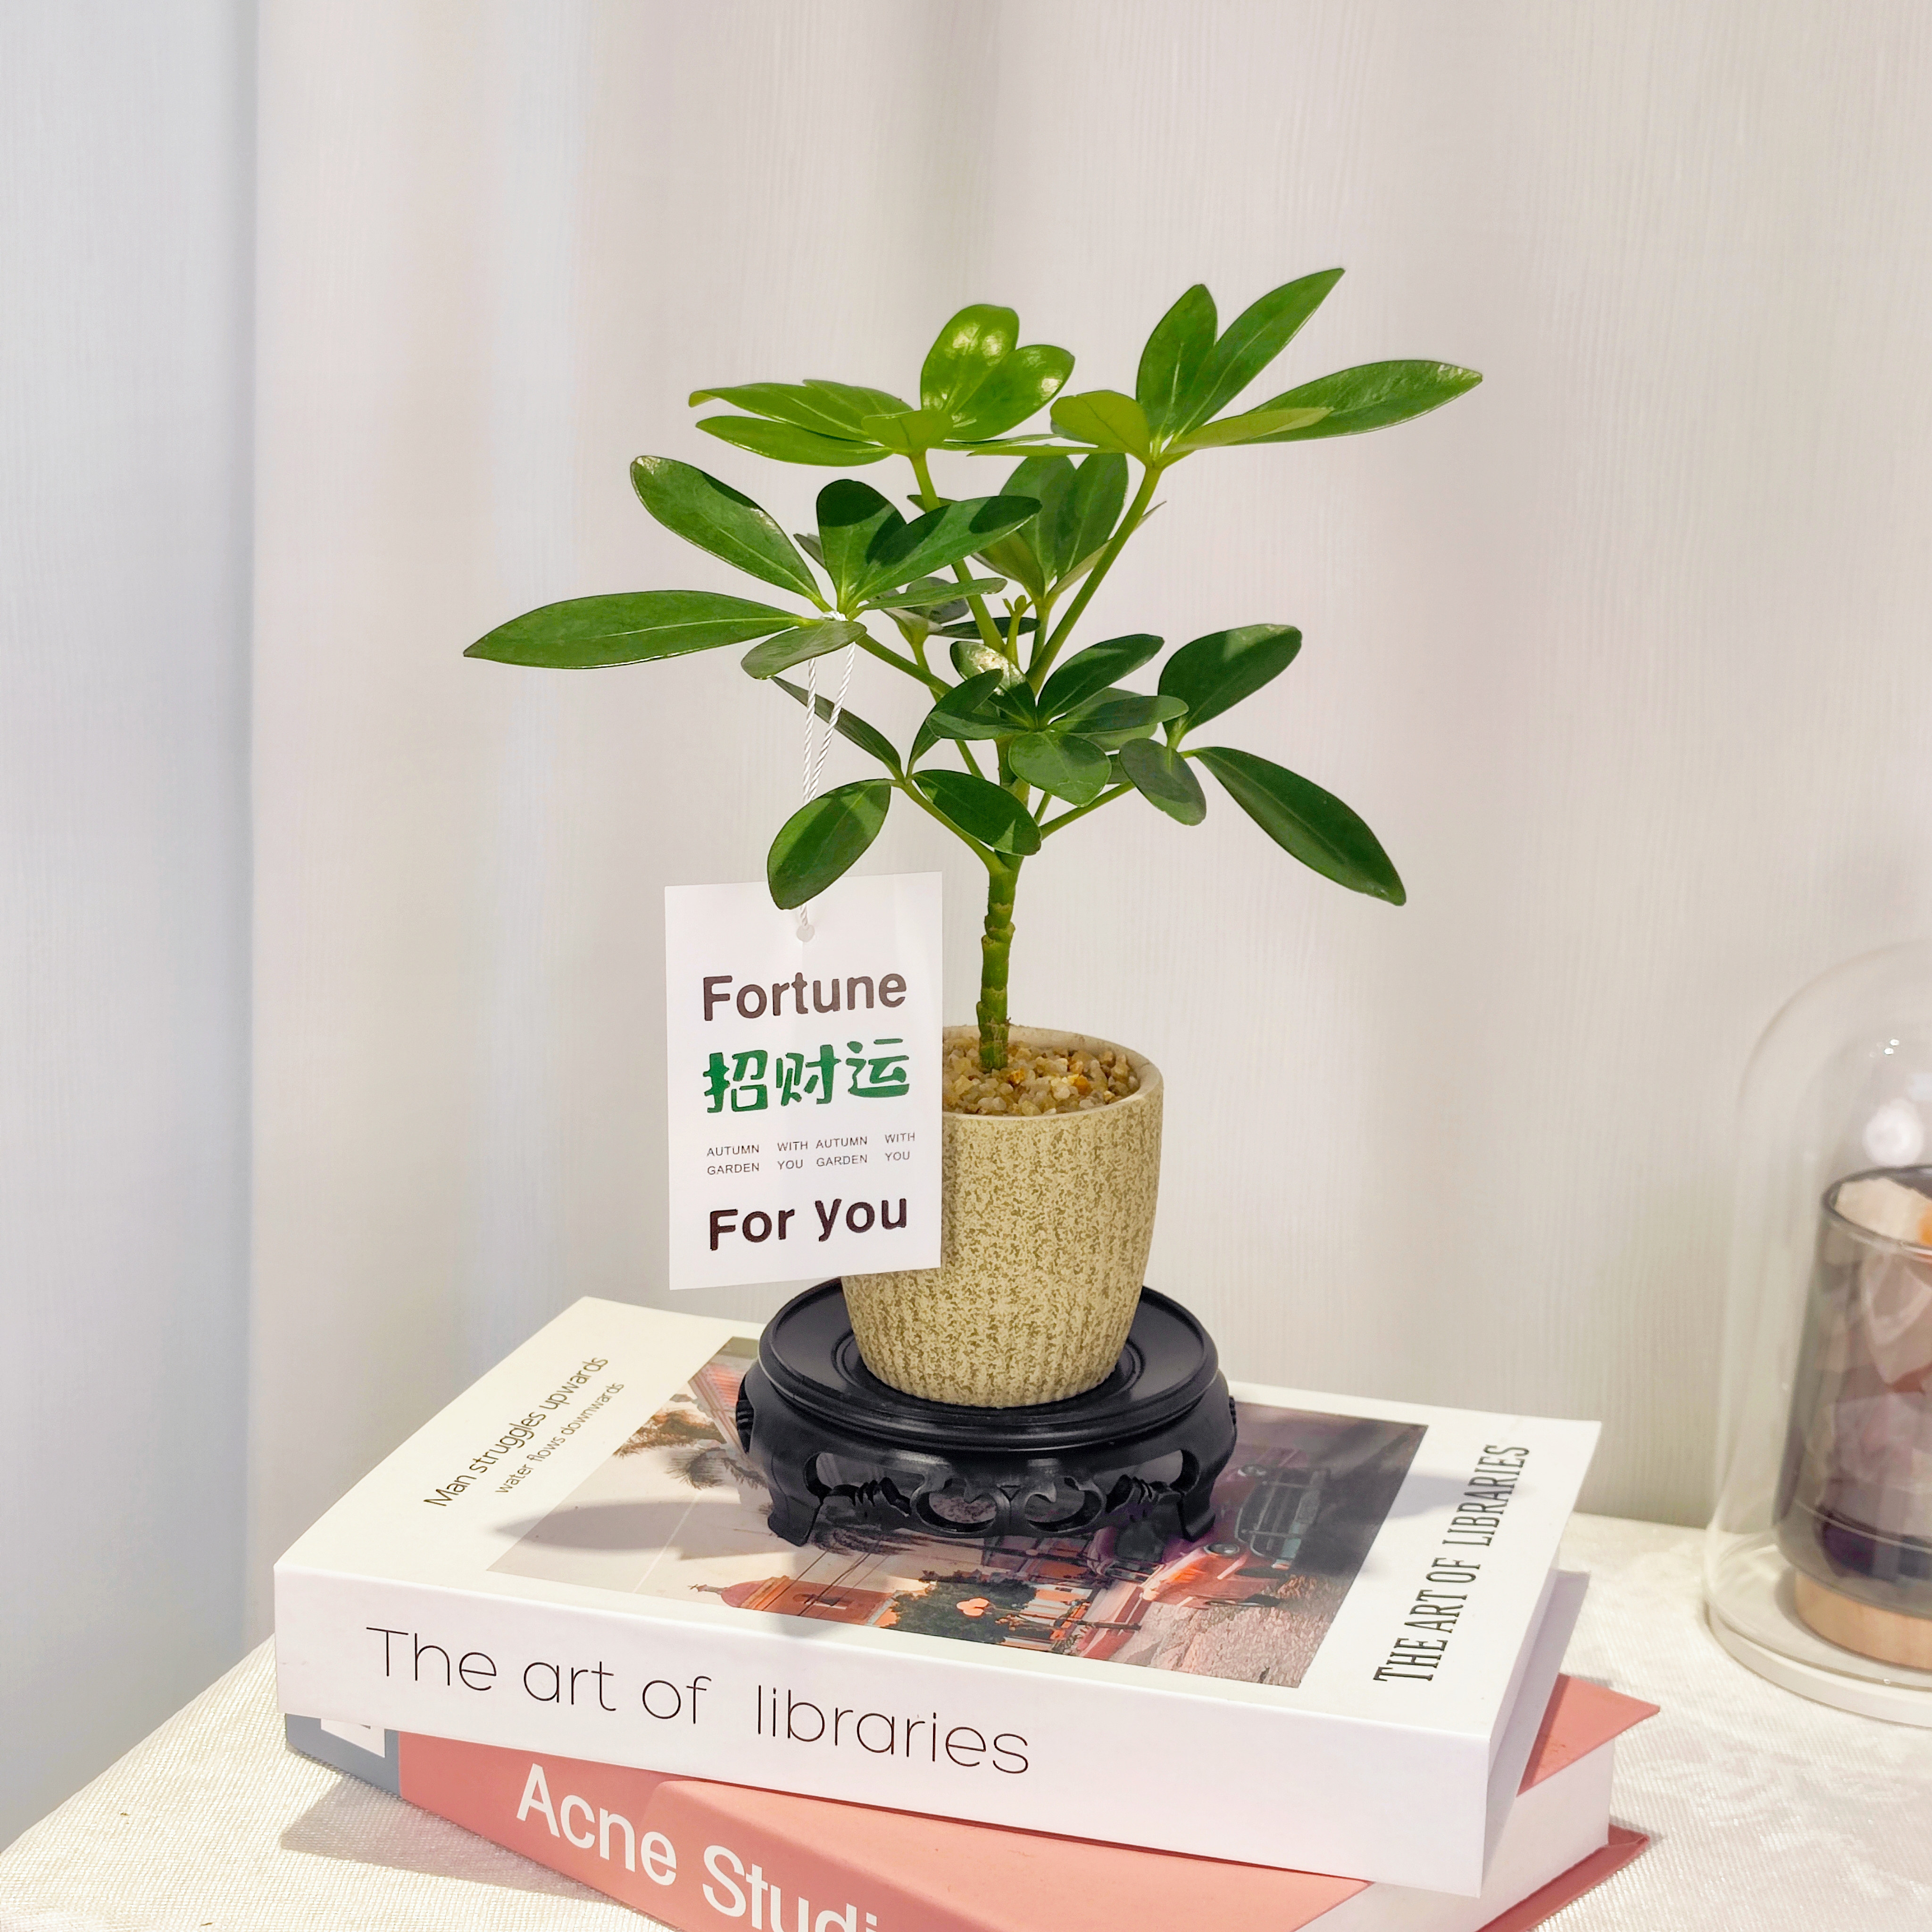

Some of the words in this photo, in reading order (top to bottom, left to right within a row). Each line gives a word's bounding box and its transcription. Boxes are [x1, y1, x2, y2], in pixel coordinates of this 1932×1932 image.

[703, 972, 907, 1022] Fortune
[702, 1038, 910, 1113] 招财运
[707, 1144, 759, 1156] AUTUMN
[777, 1141, 808, 1151] WITH
[816, 1136, 867, 1149] AUTUMN
[884, 1132, 915, 1143] WITH
[707, 1163, 759, 1175] GARDEN
[777, 1159, 803, 1170] YOU
[816, 1154, 867, 1167] GARDEN
[884, 1151, 910, 1162] YOU
[709, 1208, 795, 1251] For
[815, 1198, 907, 1242] you
[423, 1475, 477, 1507] Man
[469, 1412, 547, 1474] struggles
[539, 1357, 608, 1410] upwards
[495, 1464, 533, 1493] water
[526, 1437, 566, 1462] flows
[560, 1383, 625, 1435] downwards
[1442, 1445, 1530, 1547] LIBRARIES
[1425, 1557, 1481, 1583] OF
[1404, 1589, 1467, 1633] ART
[1373, 1638, 1448, 1682] THE
[366, 1627, 497, 1691] The
[523, 1661, 616, 1711] art
[642, 1675, 712, 1724] of
[758, 1685, 1029, 1774] libraries
[516, 1763, 677, 1885] Acne
[702, 1845, 877, 1932] Stu
